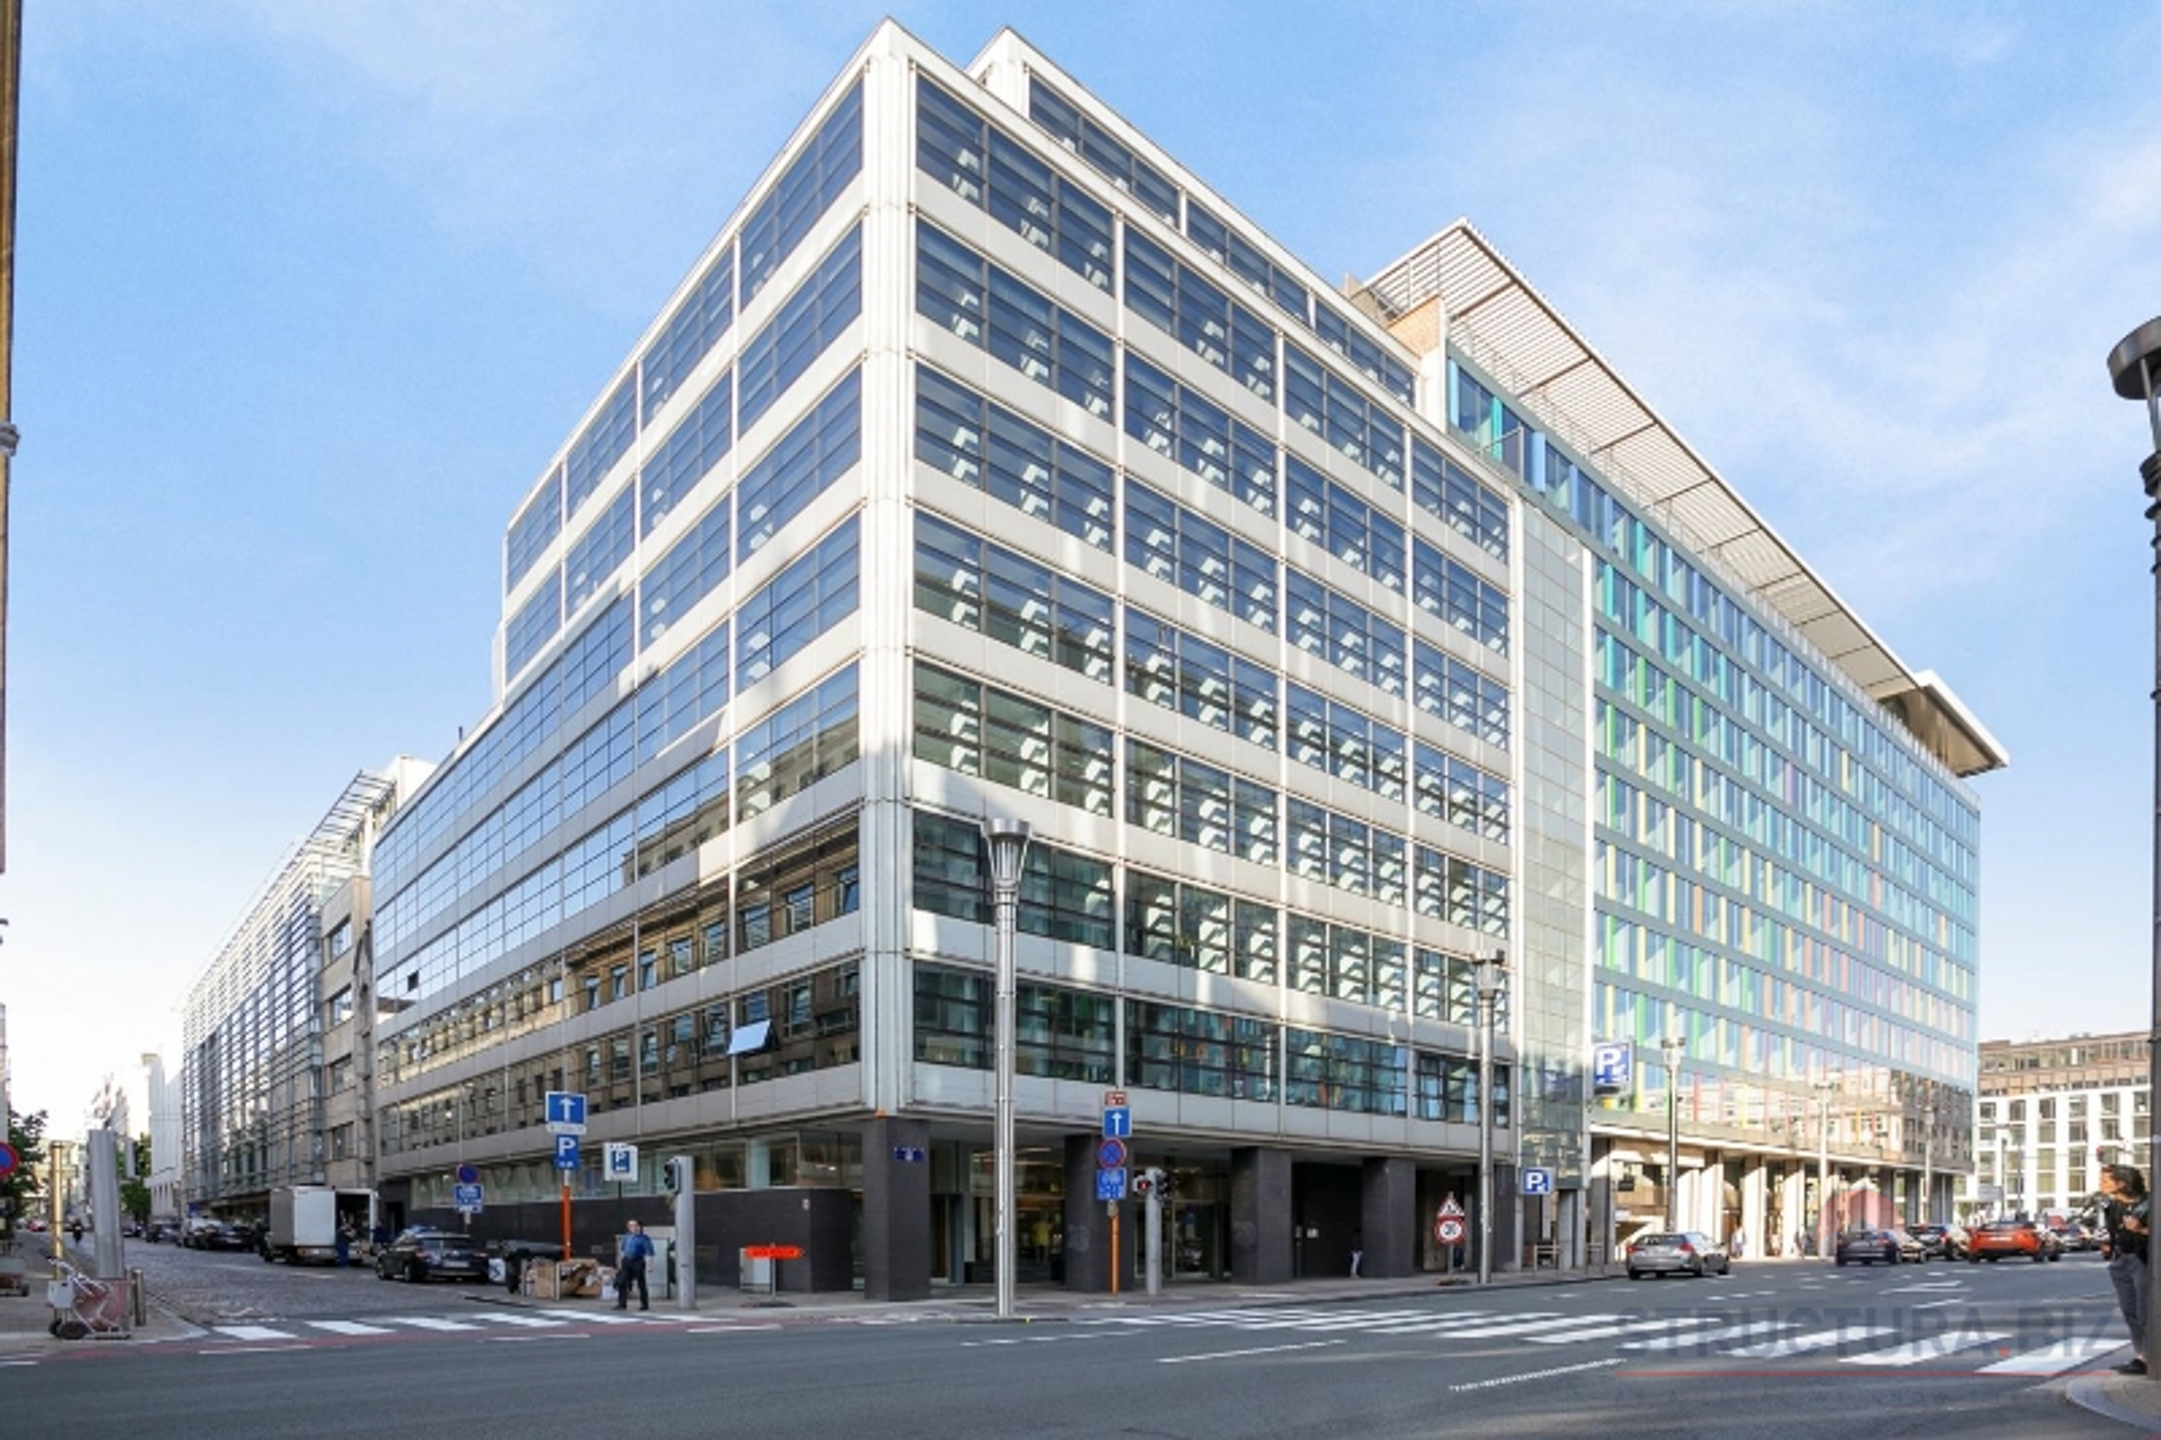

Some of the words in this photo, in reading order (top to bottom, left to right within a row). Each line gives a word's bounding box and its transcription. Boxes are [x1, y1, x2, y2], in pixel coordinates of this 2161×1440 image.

[1597, 1048, 1621, 1075] P
[558, 1137, 576, 1157] P
[1526, 1172, 1543, 1191] P
